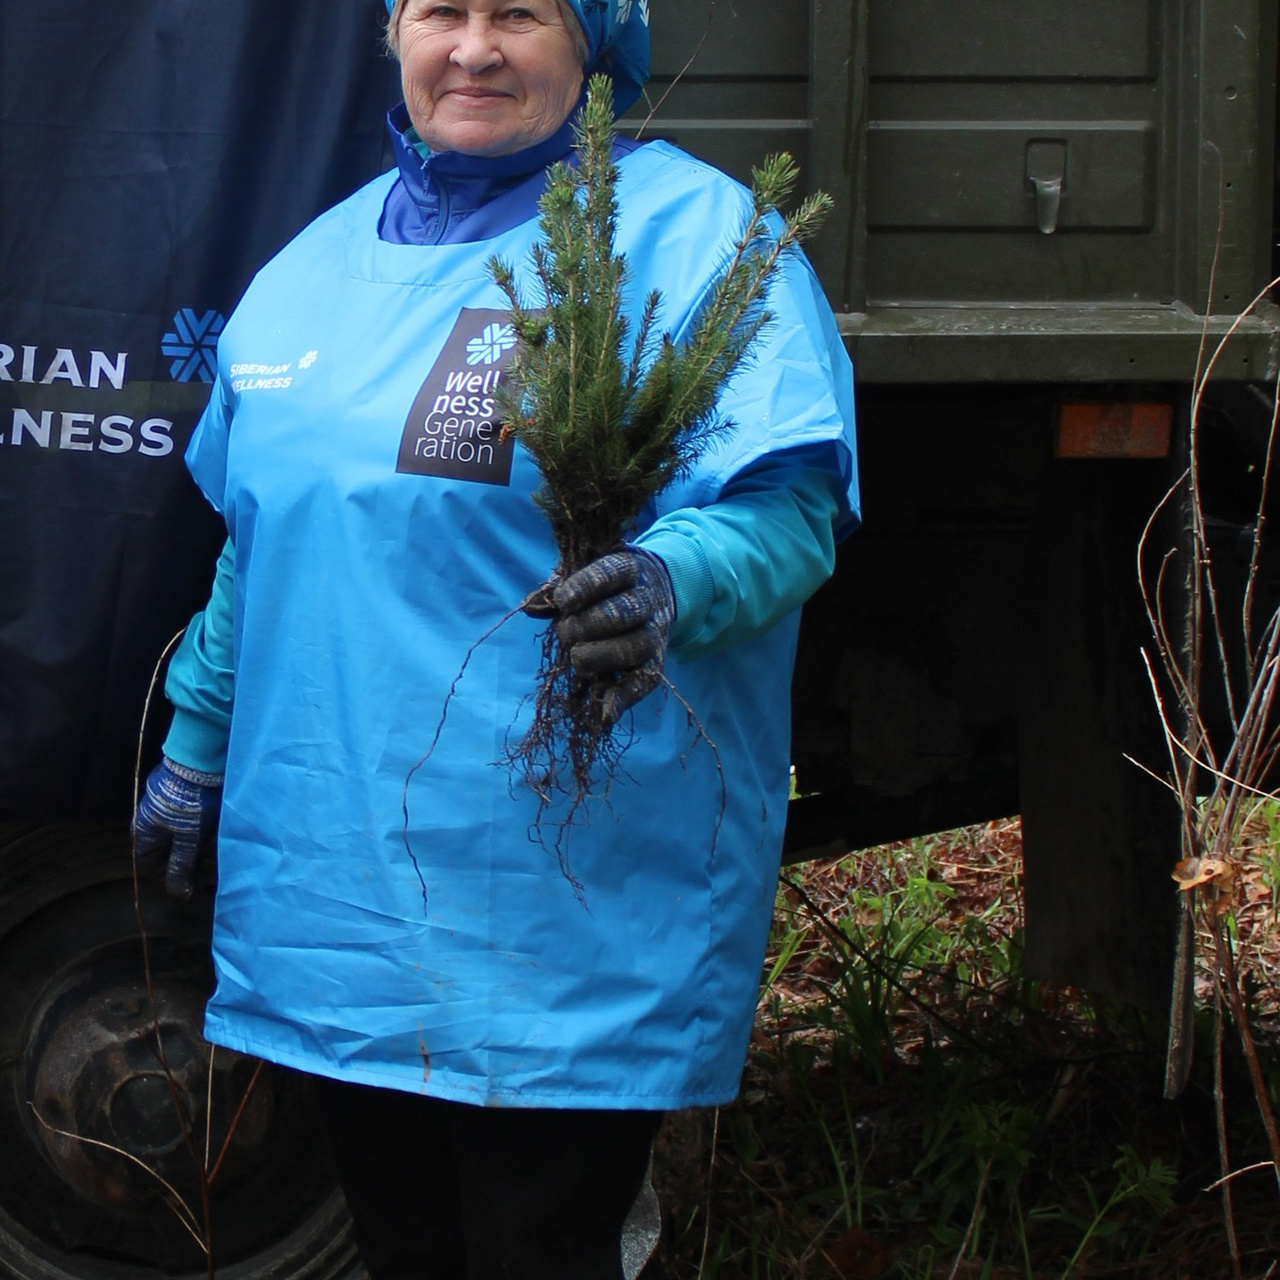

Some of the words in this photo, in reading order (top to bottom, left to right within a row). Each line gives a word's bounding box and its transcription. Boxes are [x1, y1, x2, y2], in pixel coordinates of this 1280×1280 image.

[230, 363, 291, 378] SIBERIAN
[445, 370, 500, 395] Well
[434, 393, 495, 417] ness
[424, 409, 493, 441] Gene
[413, 433, 495, 465] ration
